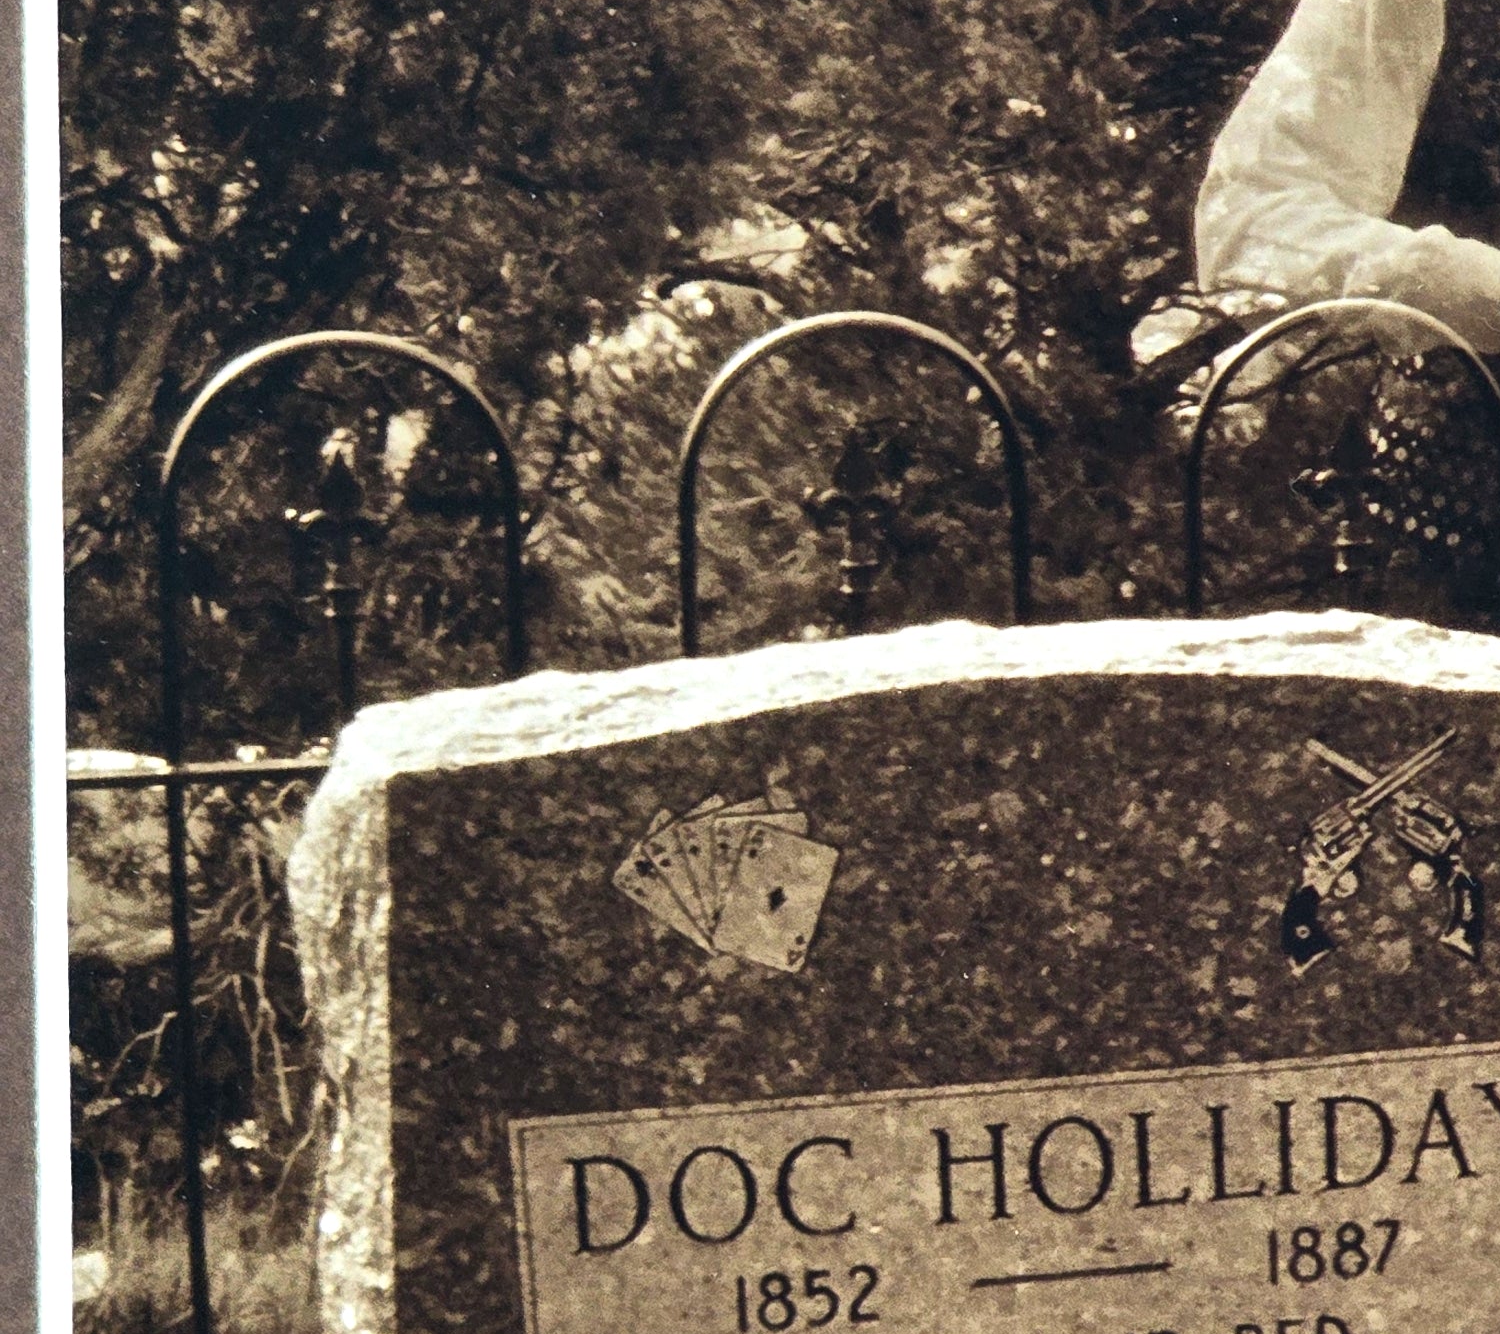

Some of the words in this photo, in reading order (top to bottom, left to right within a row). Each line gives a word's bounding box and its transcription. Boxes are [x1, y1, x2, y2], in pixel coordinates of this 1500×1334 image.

[565, 1135, 857, 1256] DOC
[737, 1264, 880, 1333] 1852
[1267, 1219, 1400, 1284] 1887
